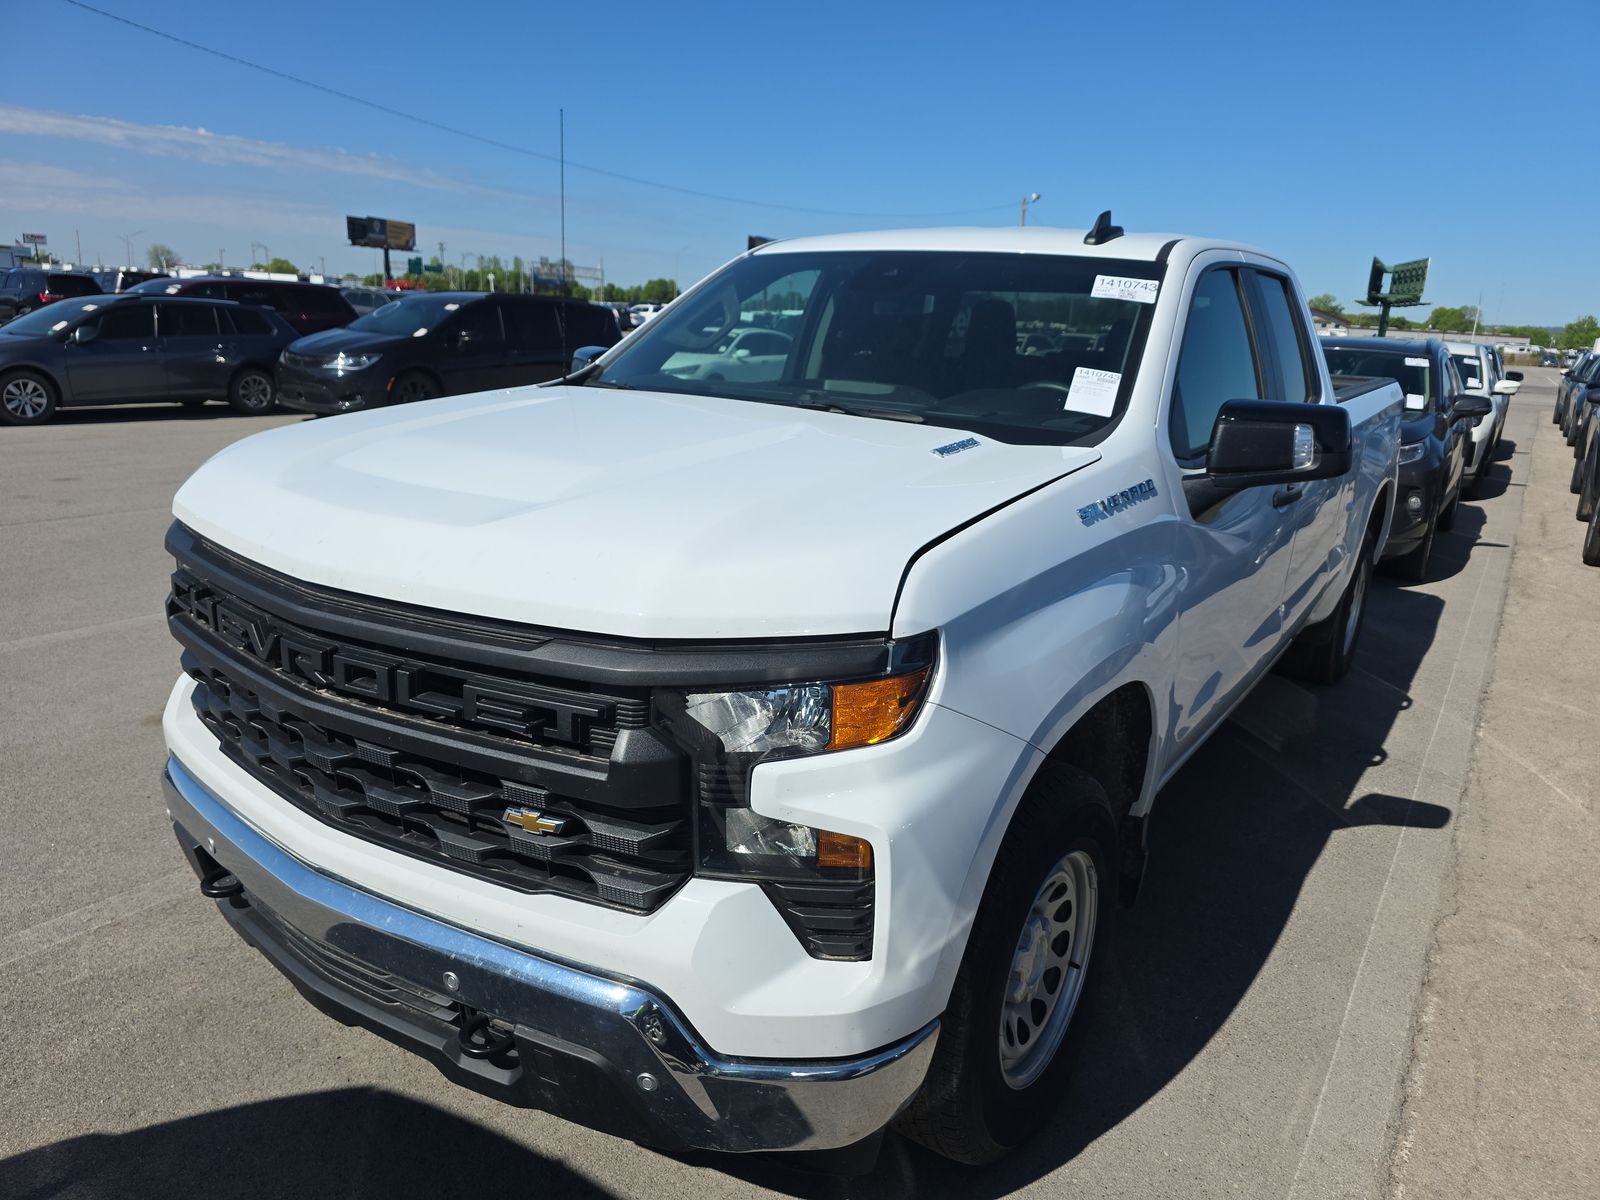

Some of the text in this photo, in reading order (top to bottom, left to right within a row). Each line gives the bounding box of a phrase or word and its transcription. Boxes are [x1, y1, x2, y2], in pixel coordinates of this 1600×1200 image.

[1099, 277, 1158, 292] 1410743
[1076, 479, 1157, 523] SILVERADO
[171, 571, 615, 743] CHEVROLET
